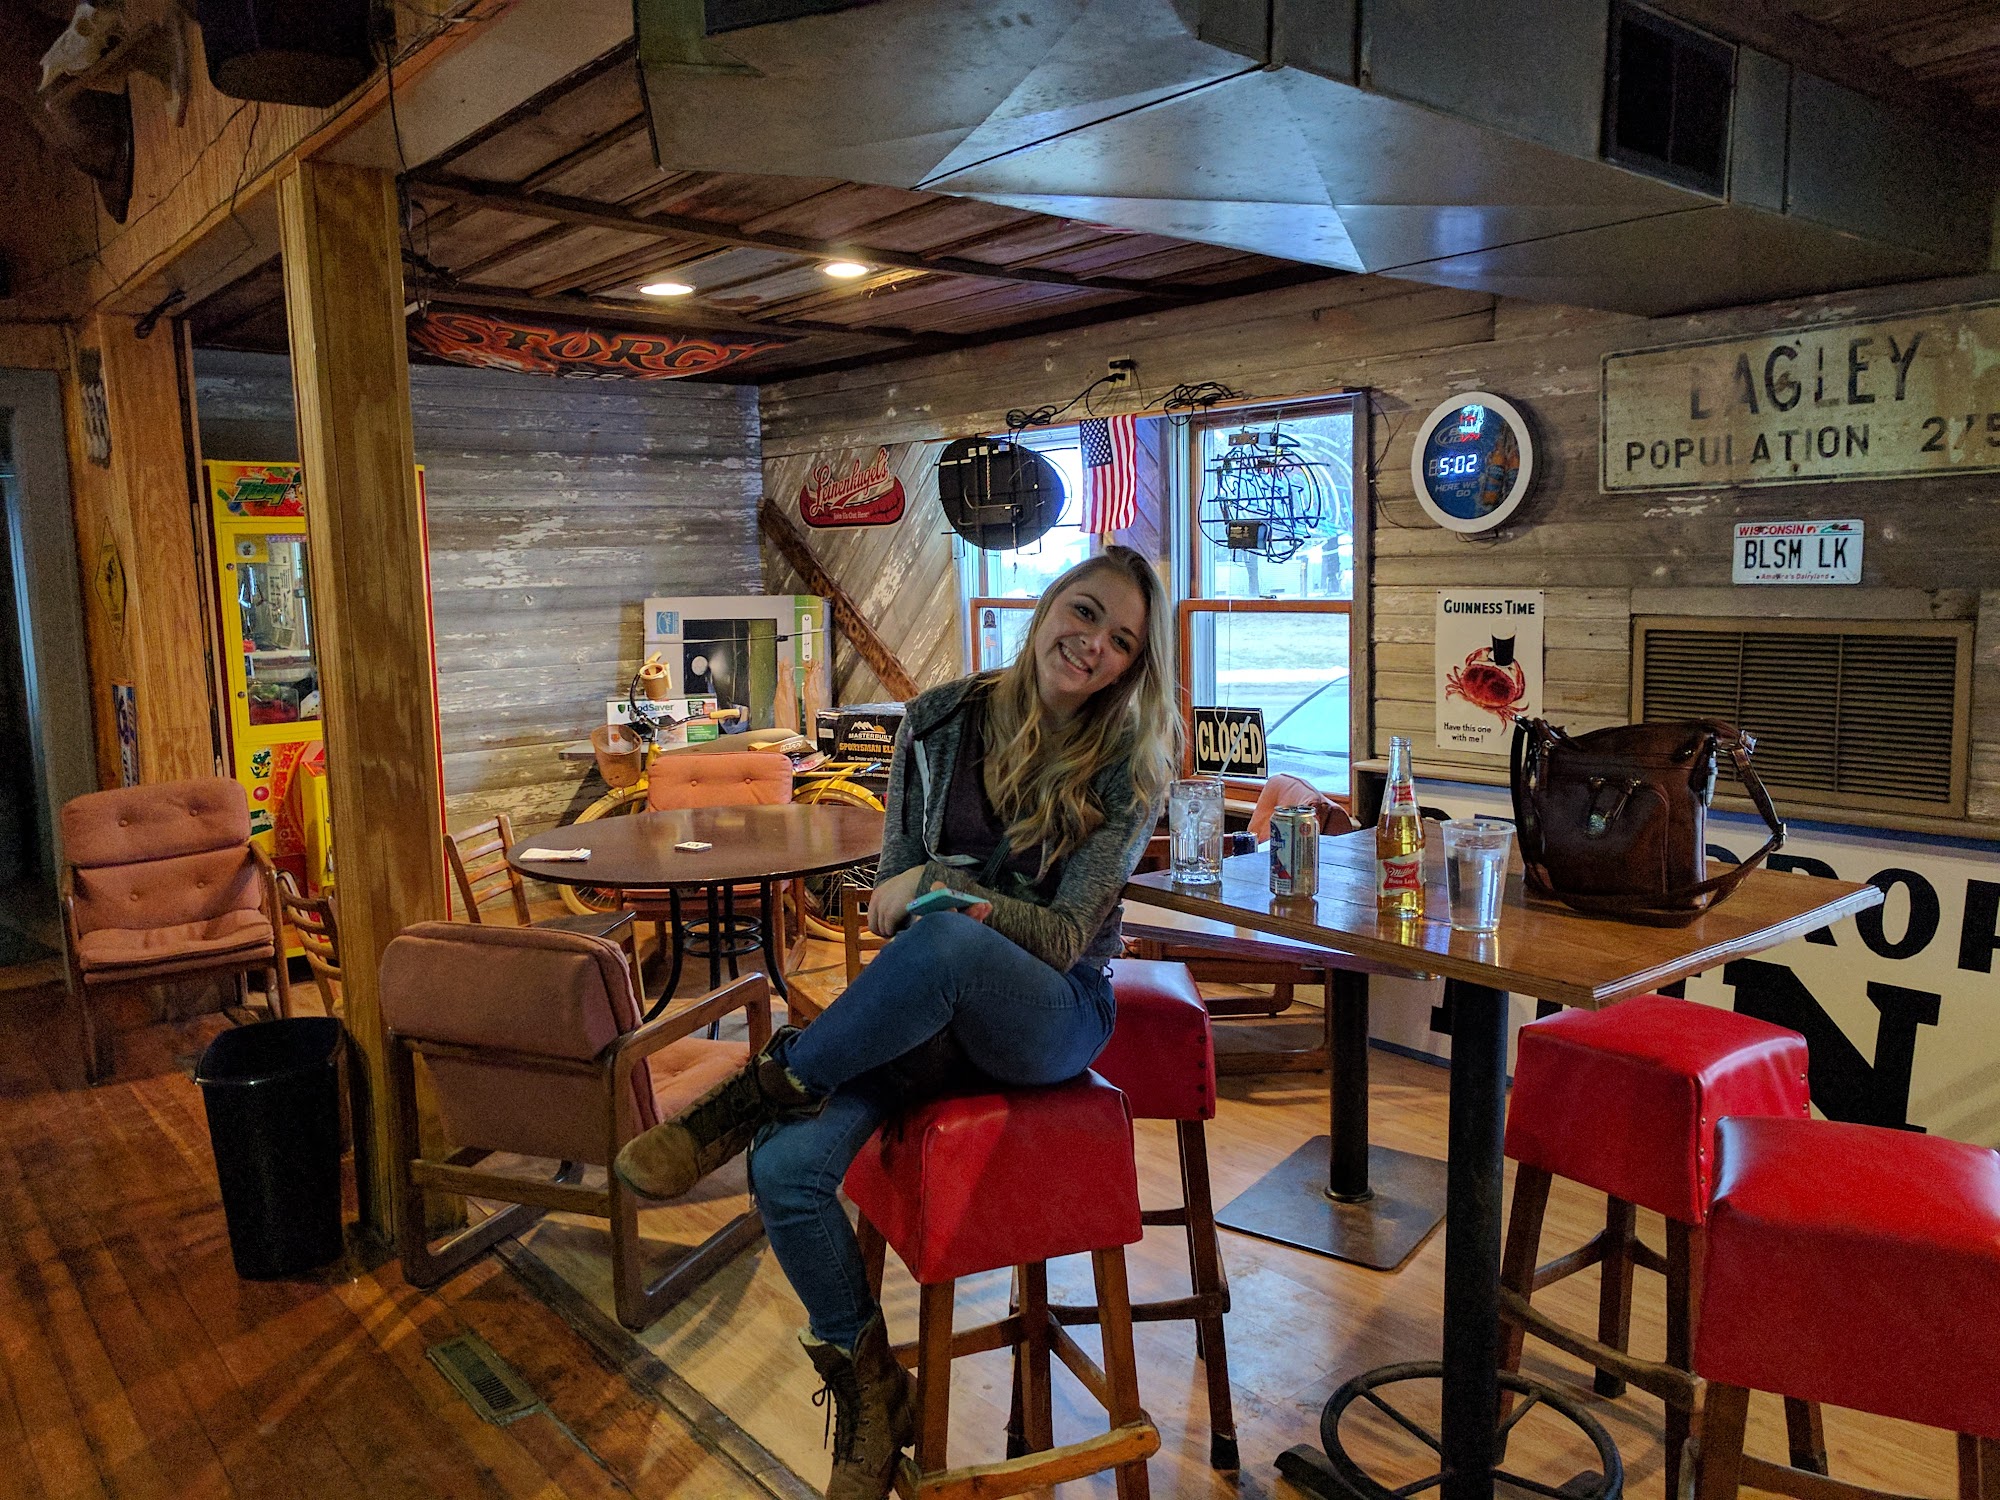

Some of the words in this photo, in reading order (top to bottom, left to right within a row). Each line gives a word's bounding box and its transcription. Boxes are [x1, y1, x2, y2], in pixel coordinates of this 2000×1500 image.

[1626, 424, 1870, 471] POPULATION
[1440, 454, 1477, 475] 5:02
[810, 447, 889, 516] Leinenkugel's
[1435, 482, 1460, 492] HERE
[1462, 481, 1478, 489] WE
[1455, 489, 1471, 497] GO
[1739, 525, 1805, 535] WISCONSIN
[1744, 538, 1802, 569] BLSM
[1819, 537, 1848, 568] LK
[1443, 722, 1461, 731] Have
[1462, 723, 1476, 732] this
[848, 732, 893, 741] MASTERBUILT
[1452, 733, 1467, 742] with
[1198, 720, 1263, 764] CLOSED
[1388, 867, 1417, 877] Miller
